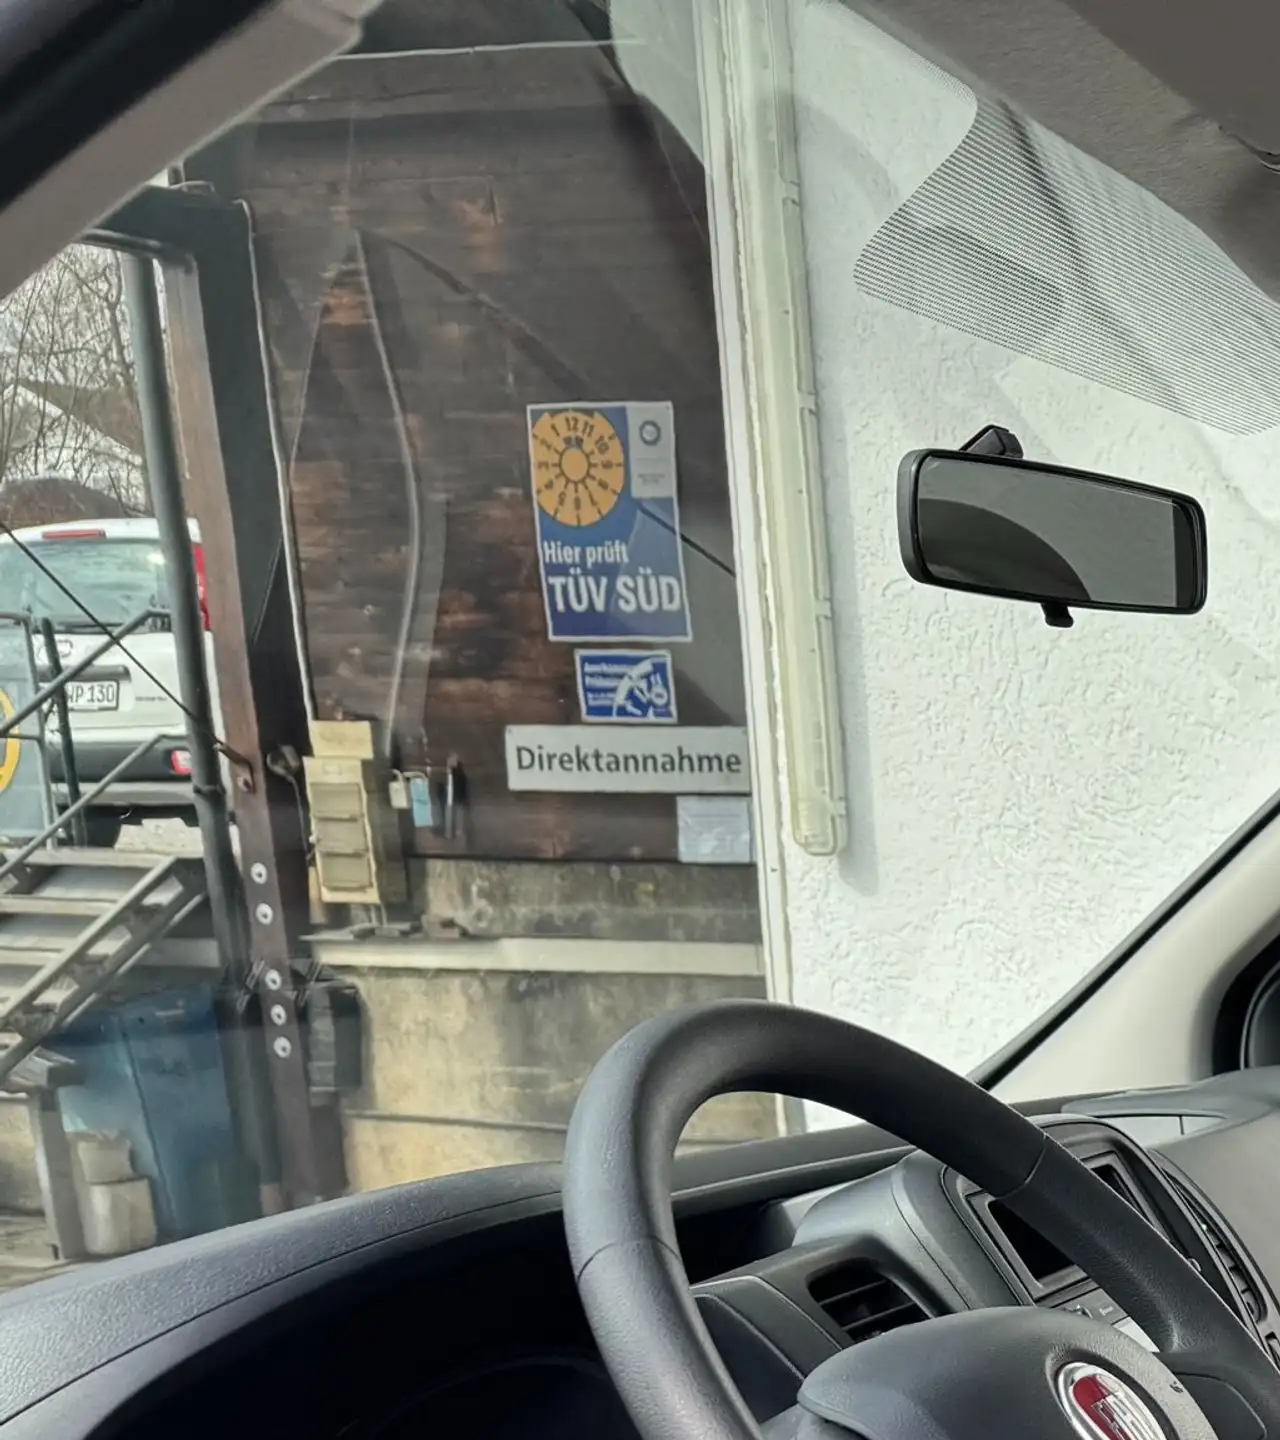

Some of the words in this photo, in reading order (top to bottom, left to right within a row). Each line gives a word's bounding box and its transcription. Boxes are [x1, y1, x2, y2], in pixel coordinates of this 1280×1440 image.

[543, 541, 580, 564] Hier
[586, 540, 629, 568] prüft
[548, 568, 608, 613] TÜV
[616, 567, 681, 613] SÜD
[87, 684, 115, 703] 130
[516, 744, 742, 773] Direktannahme
